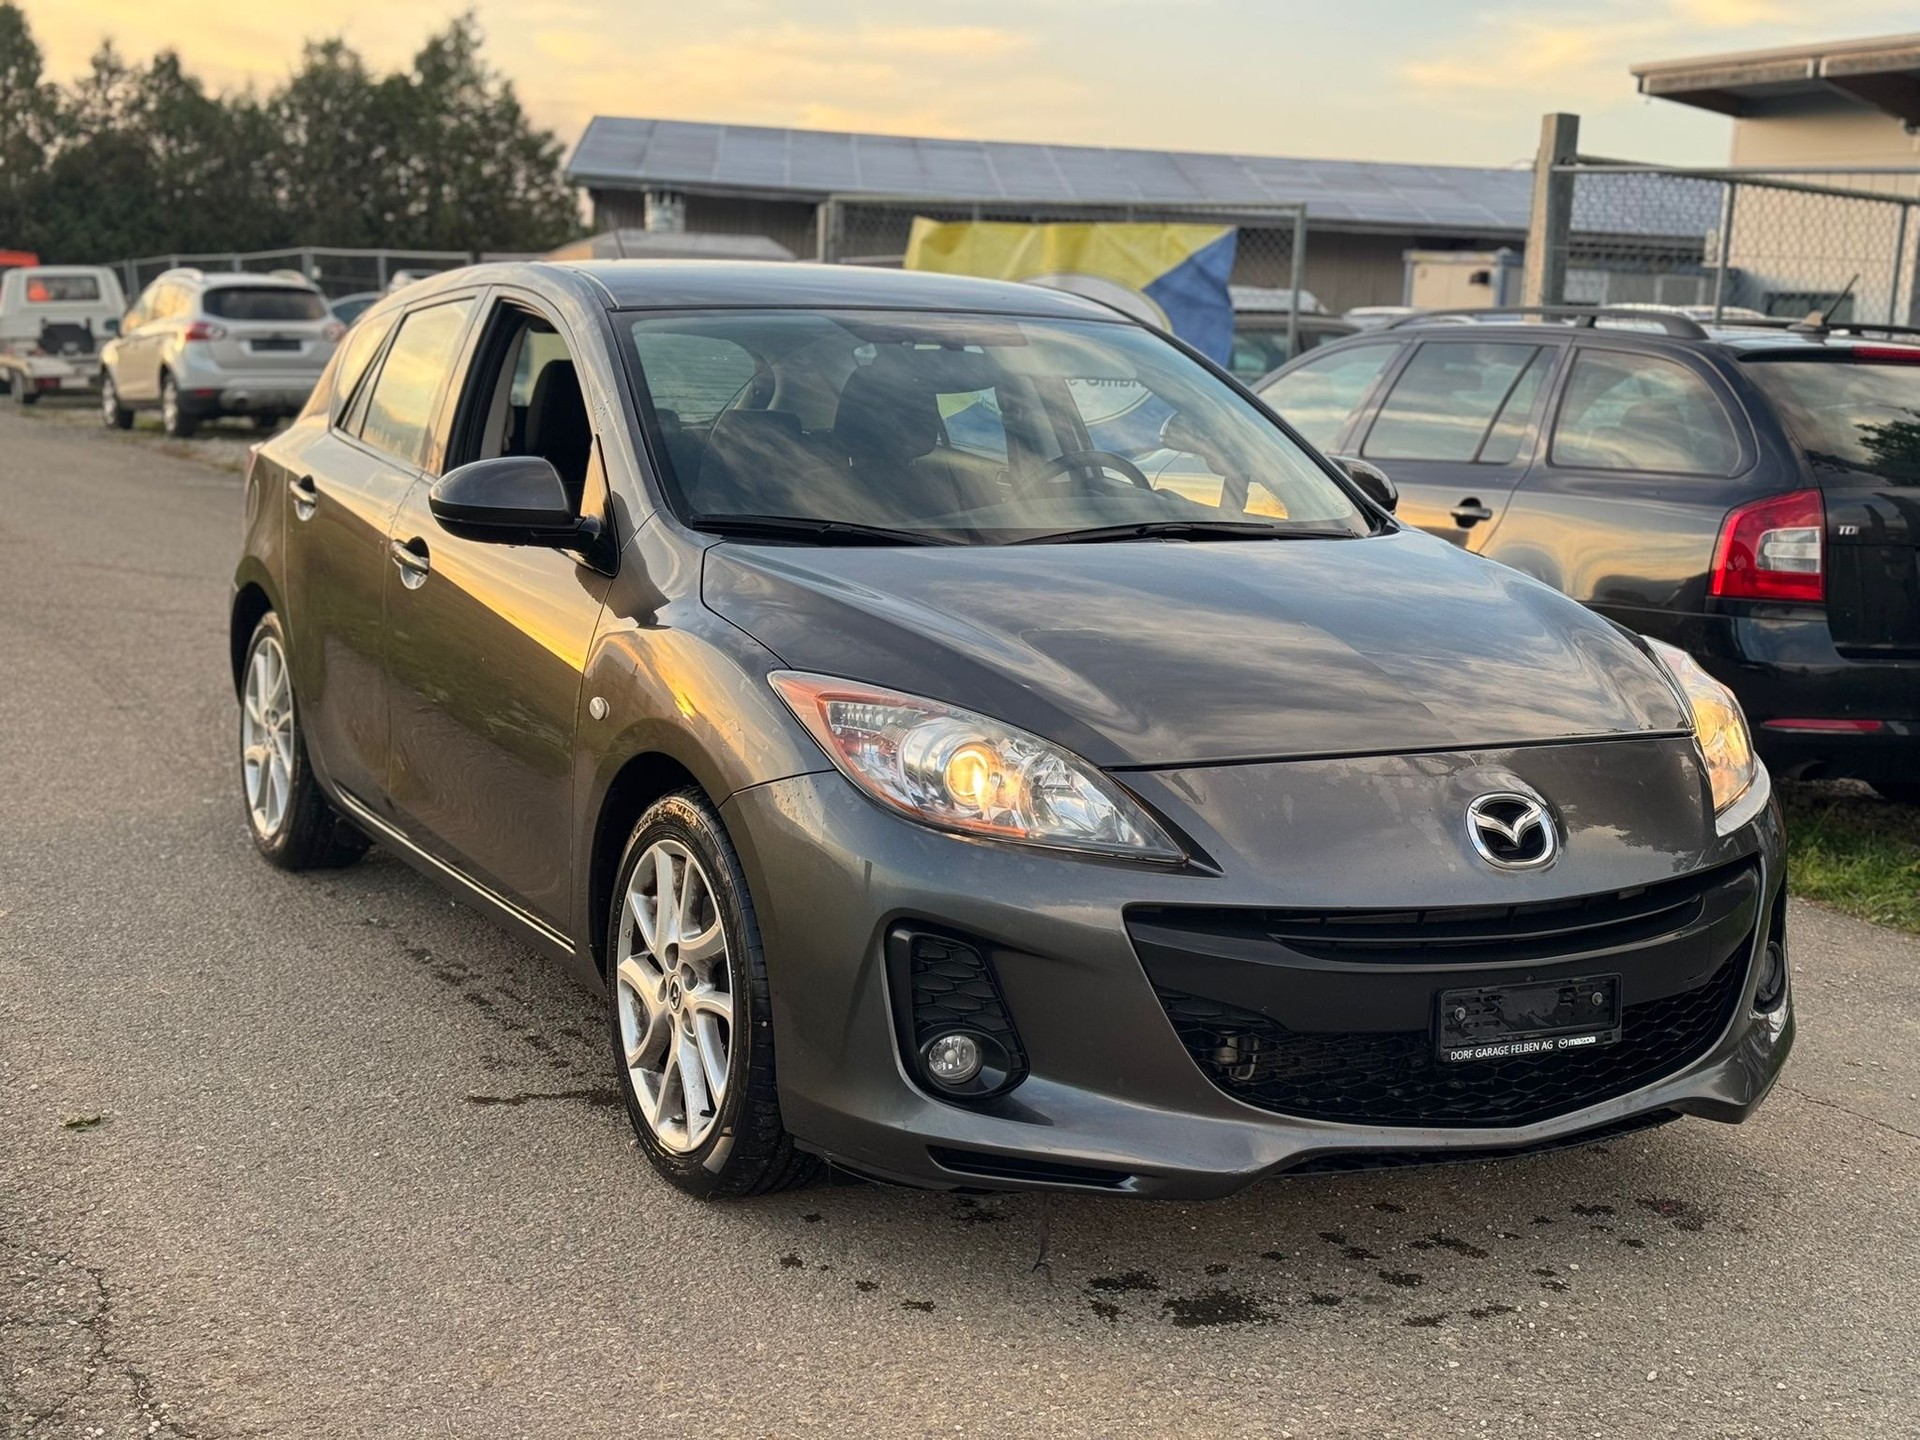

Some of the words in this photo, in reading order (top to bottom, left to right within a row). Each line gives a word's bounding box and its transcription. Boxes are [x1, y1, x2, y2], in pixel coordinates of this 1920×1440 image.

[1838, 525, 1860, 535] TDI
[1450, 1050, 1474, 1061] DORF
[1475, 1045, 1509, 1058] GARAGE
[1511, 1041, 1540, 1054] FELBEN
[1541, 1040, 1554, 1051] AG
